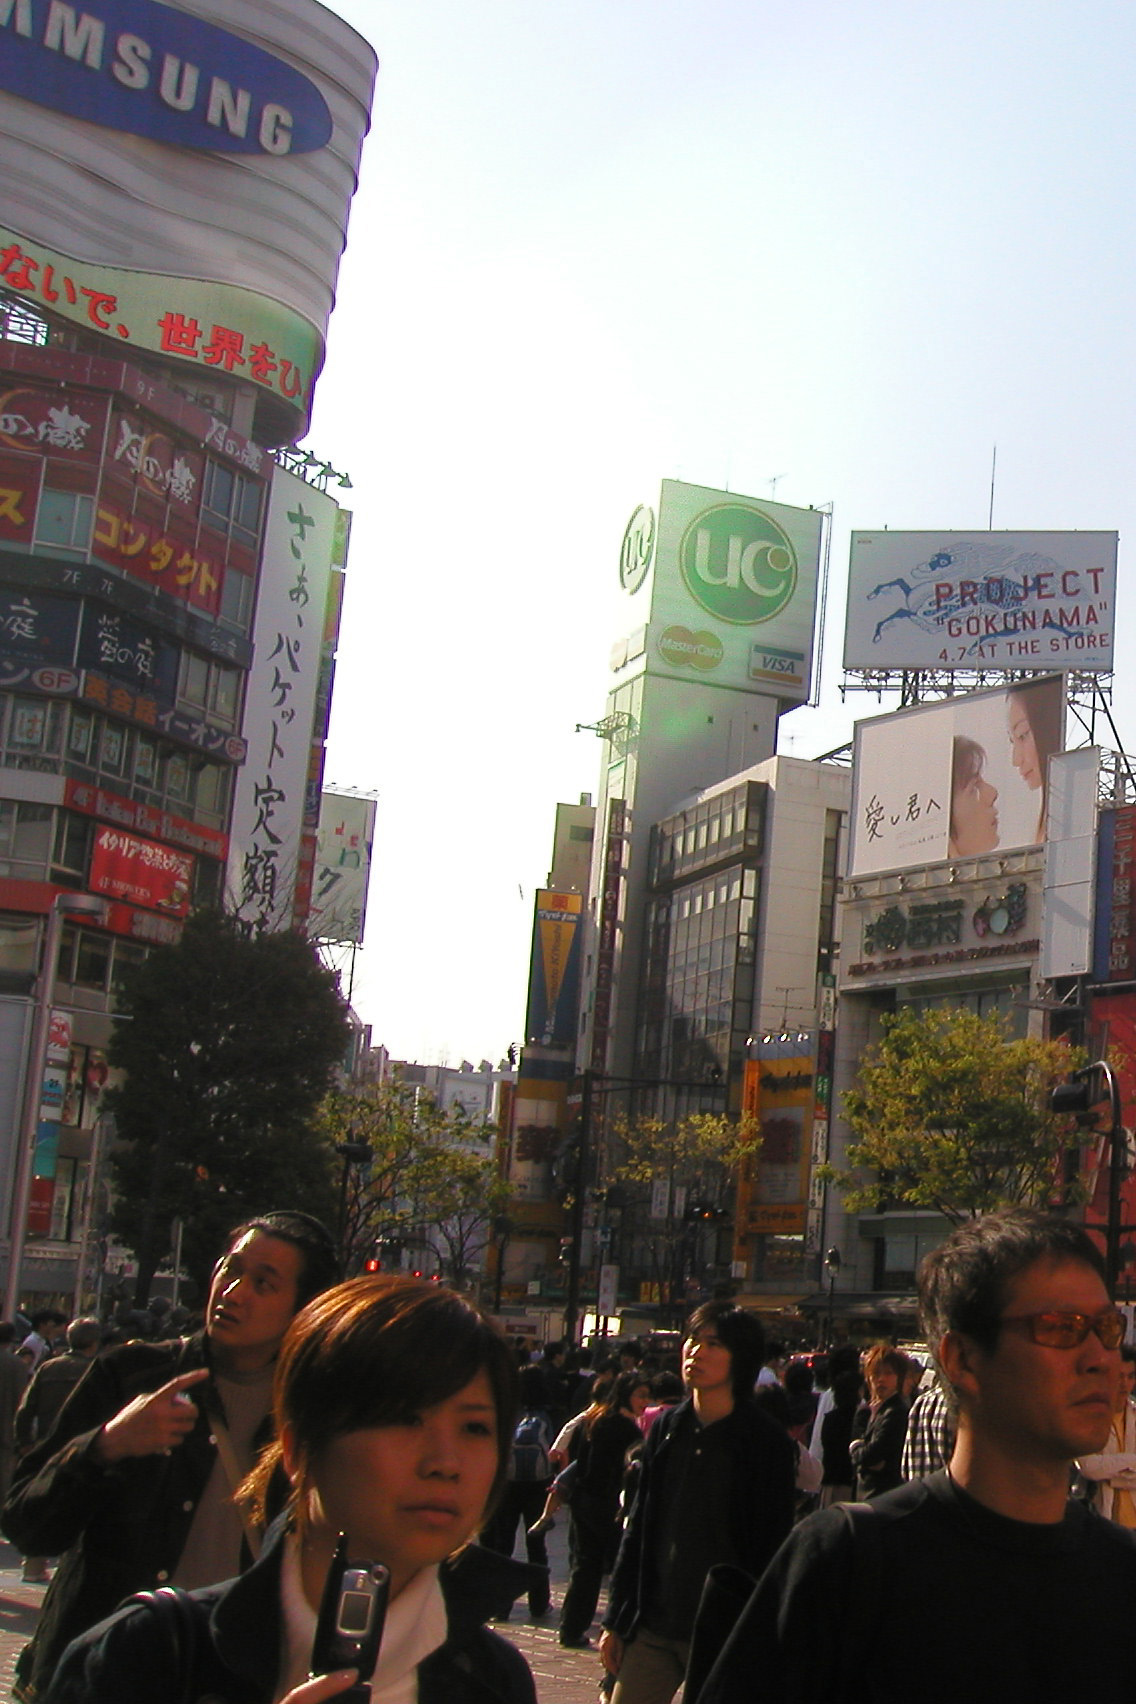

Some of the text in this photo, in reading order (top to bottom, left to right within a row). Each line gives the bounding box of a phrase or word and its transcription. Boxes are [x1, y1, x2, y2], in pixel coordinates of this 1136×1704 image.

[94, 508, 218, 596] コンタクト
[934, 567, 1105, 609] PROJECT
[938, 647, 966, 662] 4.7
[977, 644, 997, 659] AT
[1006, 639, 1040, 656] THE
[1050, 633, 1110, 651] STORE
[761, 655, 796, 674] VISA
[39, 672, 72, 689] 6F
